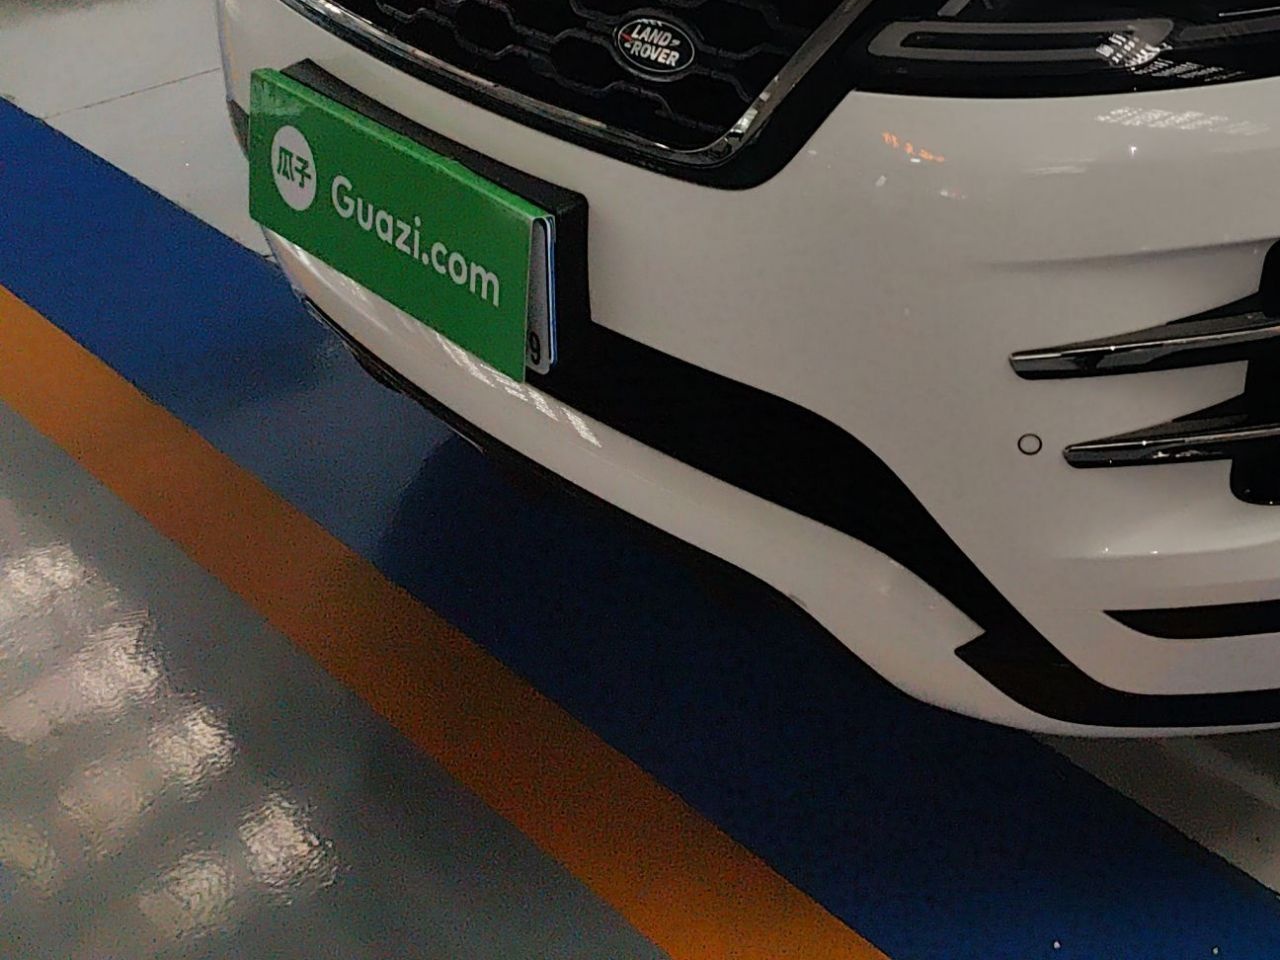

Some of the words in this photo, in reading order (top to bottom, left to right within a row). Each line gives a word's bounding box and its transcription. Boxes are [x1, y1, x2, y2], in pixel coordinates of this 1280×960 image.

[631, 24, 672, 46] LAND
[630, 41, 680, 67] ROVER
[276, 146, 312, 189] 瓜子
[331, 175, 500, 307] Guazi.com
